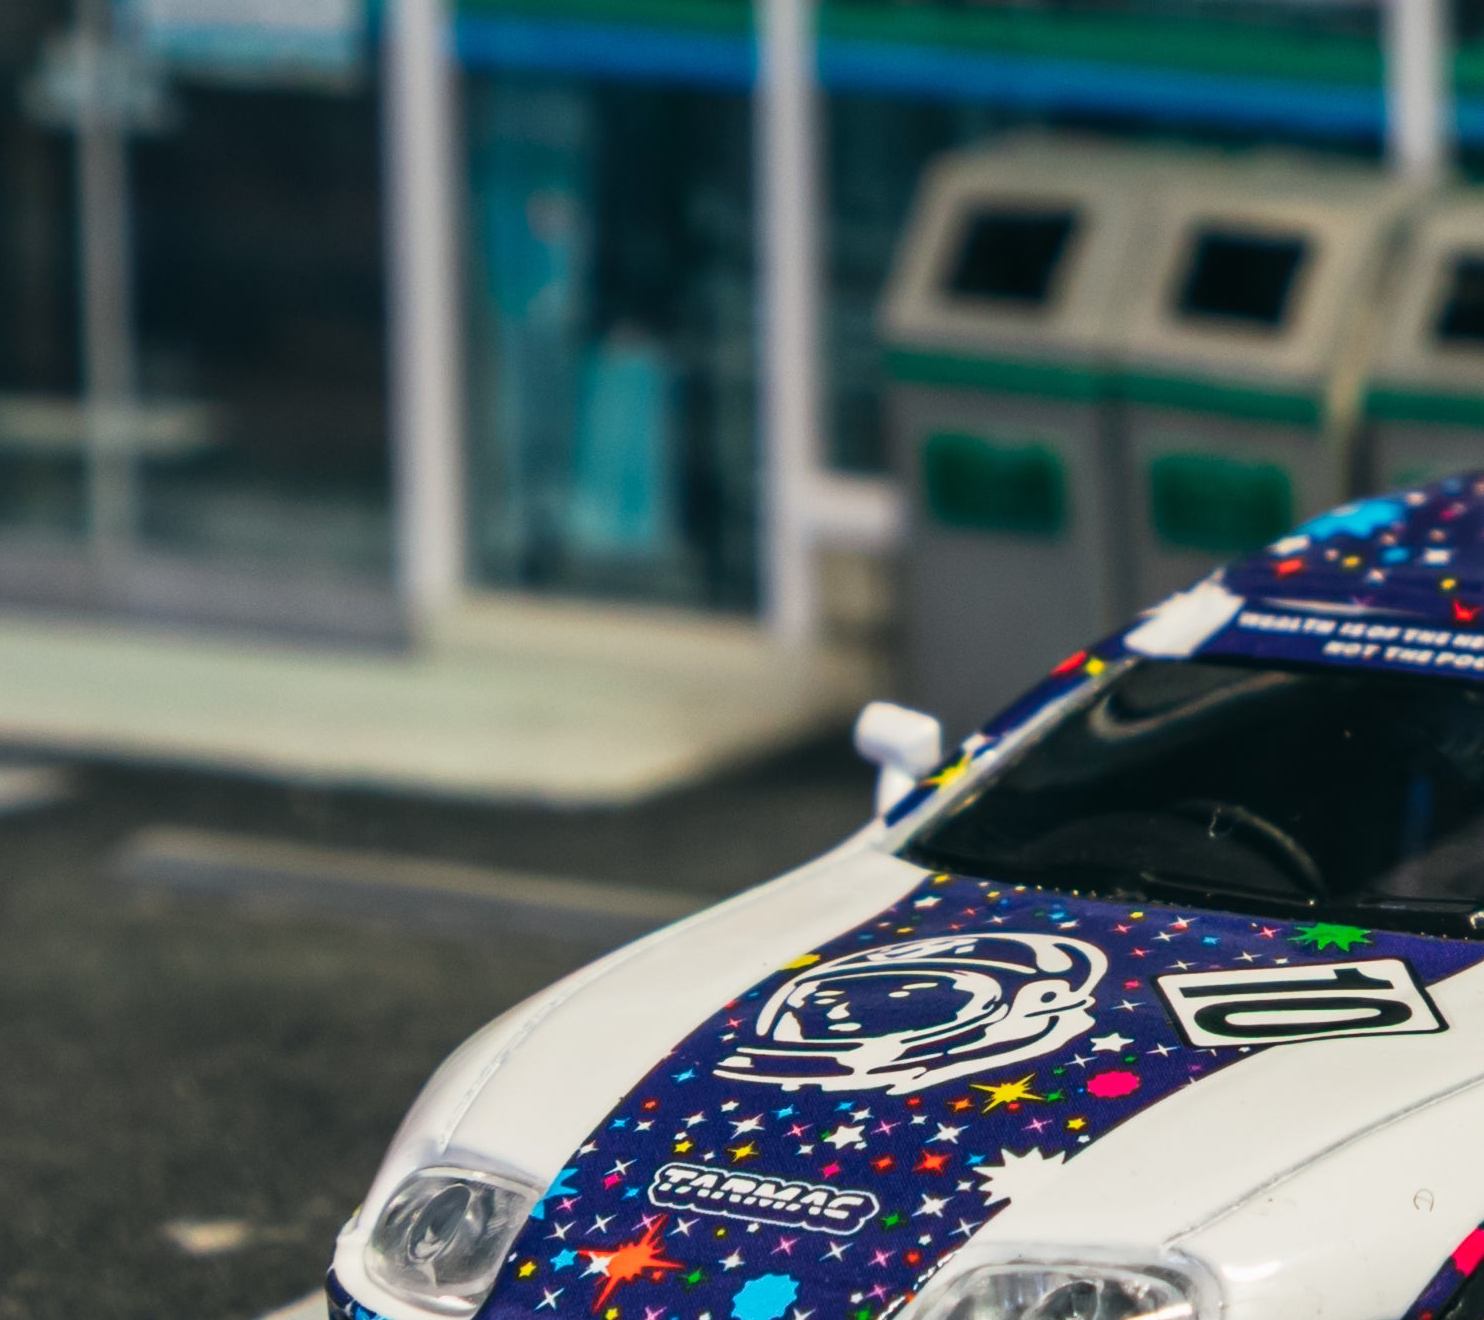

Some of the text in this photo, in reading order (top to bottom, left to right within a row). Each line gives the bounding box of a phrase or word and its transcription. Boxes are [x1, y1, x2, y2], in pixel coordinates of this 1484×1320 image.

[1238, 611, 1337, 636] WEALTH
[1366, 624, 1401, 641] OF
[1403, 627, 1453, 648] THE
[1323, 640, 1380, 660] NOT
[1383, 645, 1434, 666] THE
[1178, 967, 1414, 1039] 10
[658, 1167, 865, 1220] TARMAC
